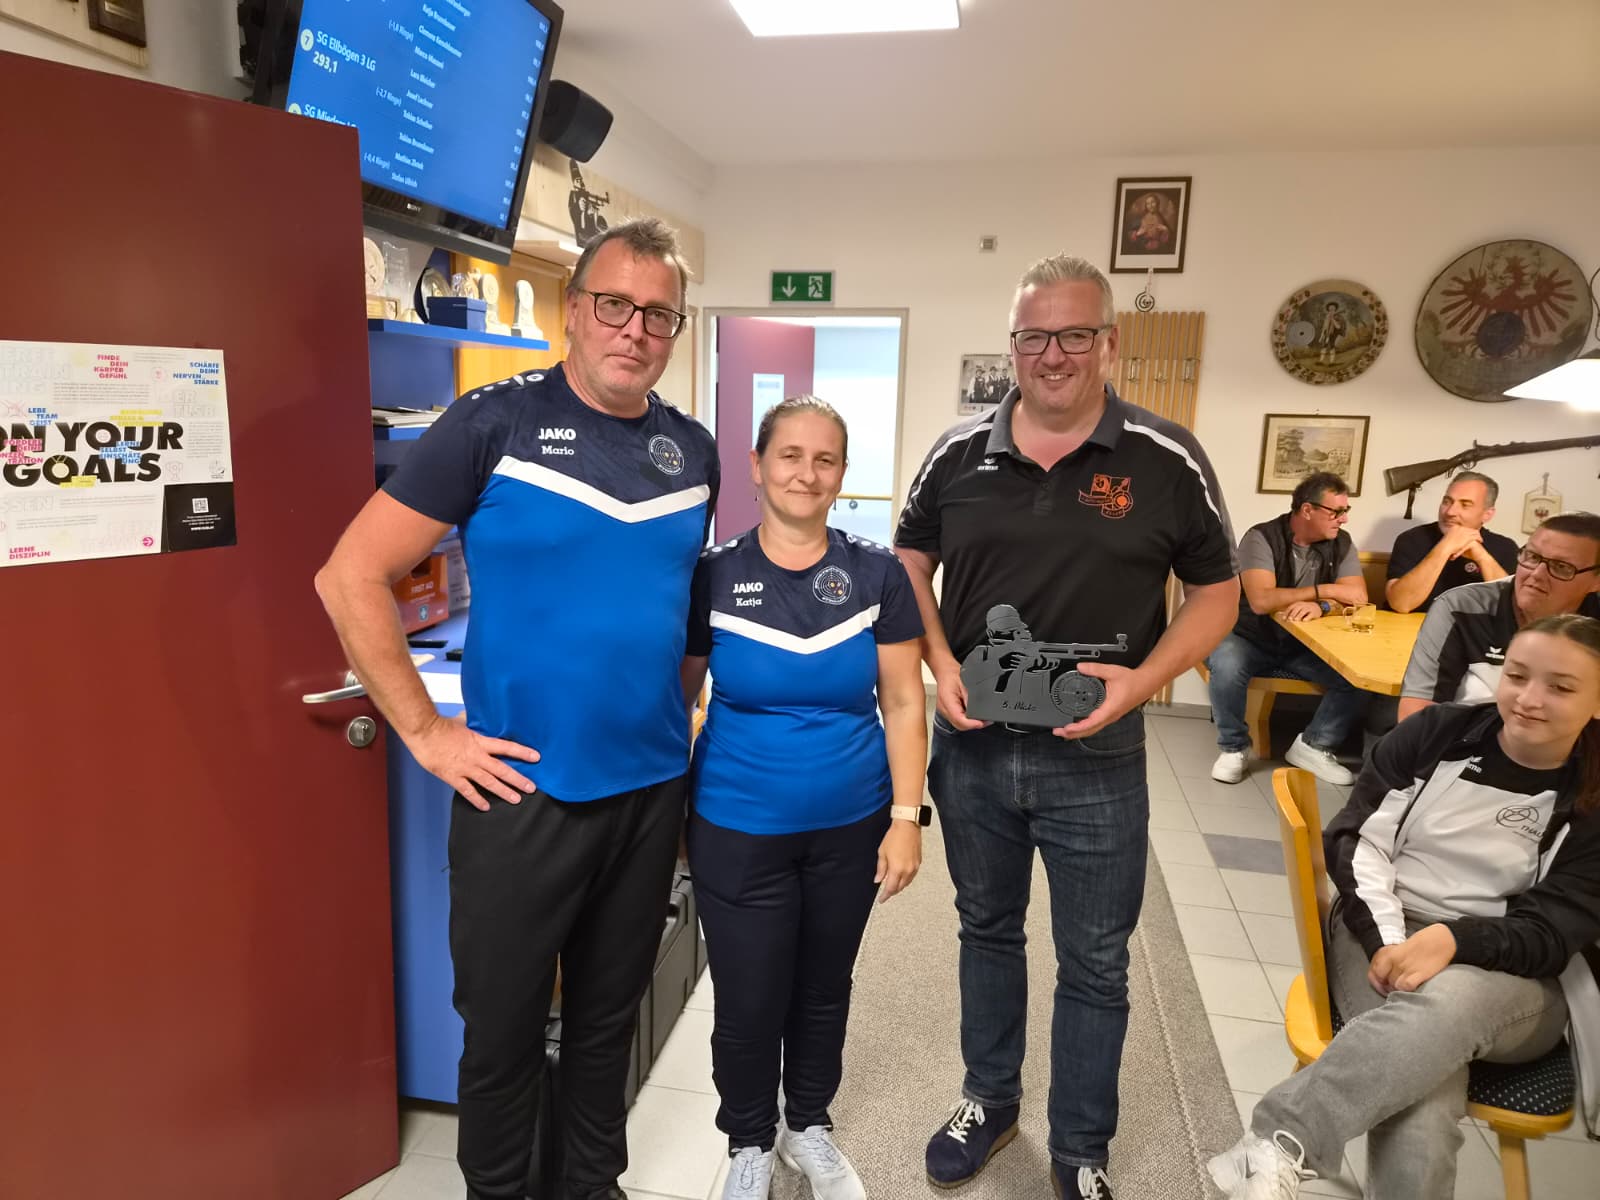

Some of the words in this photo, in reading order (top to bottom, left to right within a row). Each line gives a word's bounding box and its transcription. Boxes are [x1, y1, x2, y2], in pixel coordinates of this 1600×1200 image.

[316, 31, 329, 46] SG
[328, 37, 360, 64] Ellbögen
[359, 54, 366, 67] 3
[365, 57, 377, 71] LG
[312, 50, 338, 73] 293,1
[303, 103, 316, 119] SG
[0, 422, 46, 453] N
[55, 421, 183, 451] YOUR
[538, 427, 577, 441] JAKO
[541, 445, 575, 456] Mario
[3, 451, 162, 488] GOALS
[9, 546, 35, 554] LERNE
[9, 551, 51, 560] DISZIPLIN
[732, 581, 764, 594] JAKO
[735, 597, 763, 608] Katja
